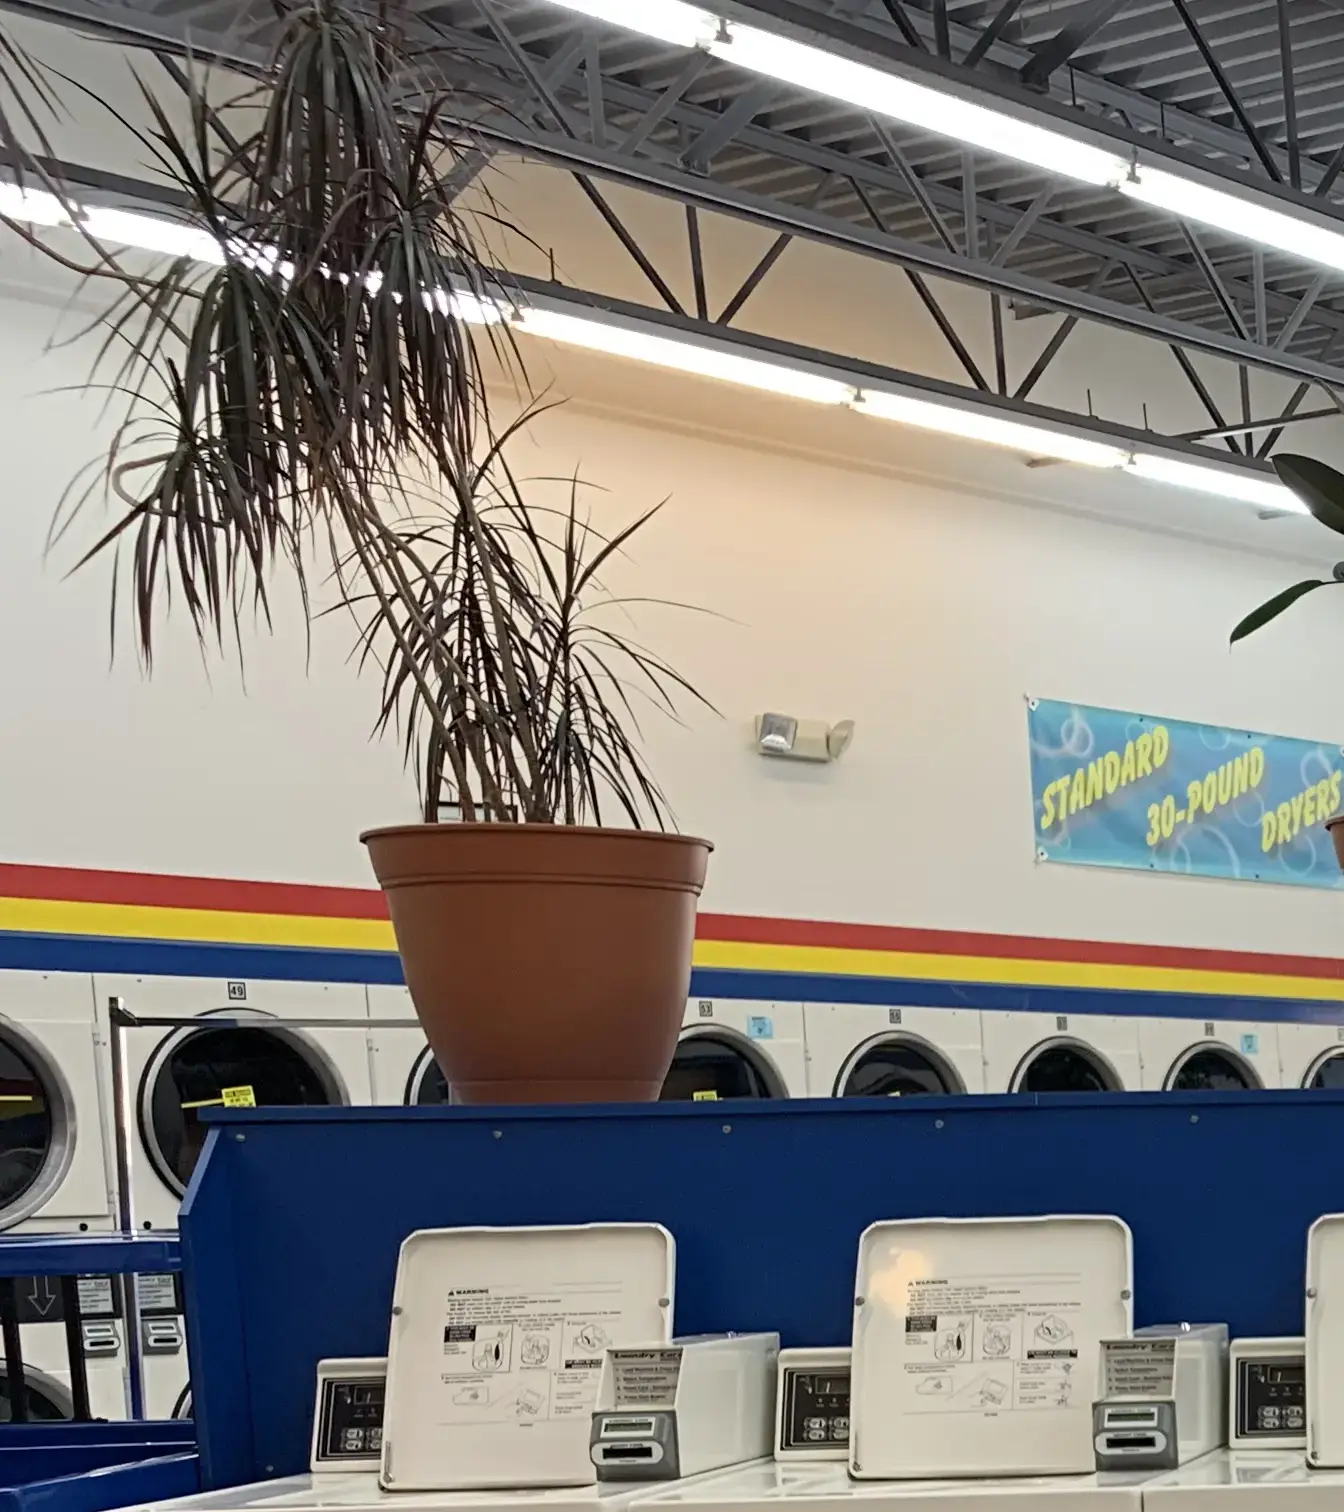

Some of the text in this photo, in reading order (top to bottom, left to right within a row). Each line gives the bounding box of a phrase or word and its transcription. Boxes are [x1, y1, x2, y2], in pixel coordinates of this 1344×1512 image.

[1041, 725, 1170, 830] STANDARD
[1146, 746, 1265, 847] 30-POUND
[1261, 769, 1342, 852] DRYERS
[230, 985, 244, 997] 49
